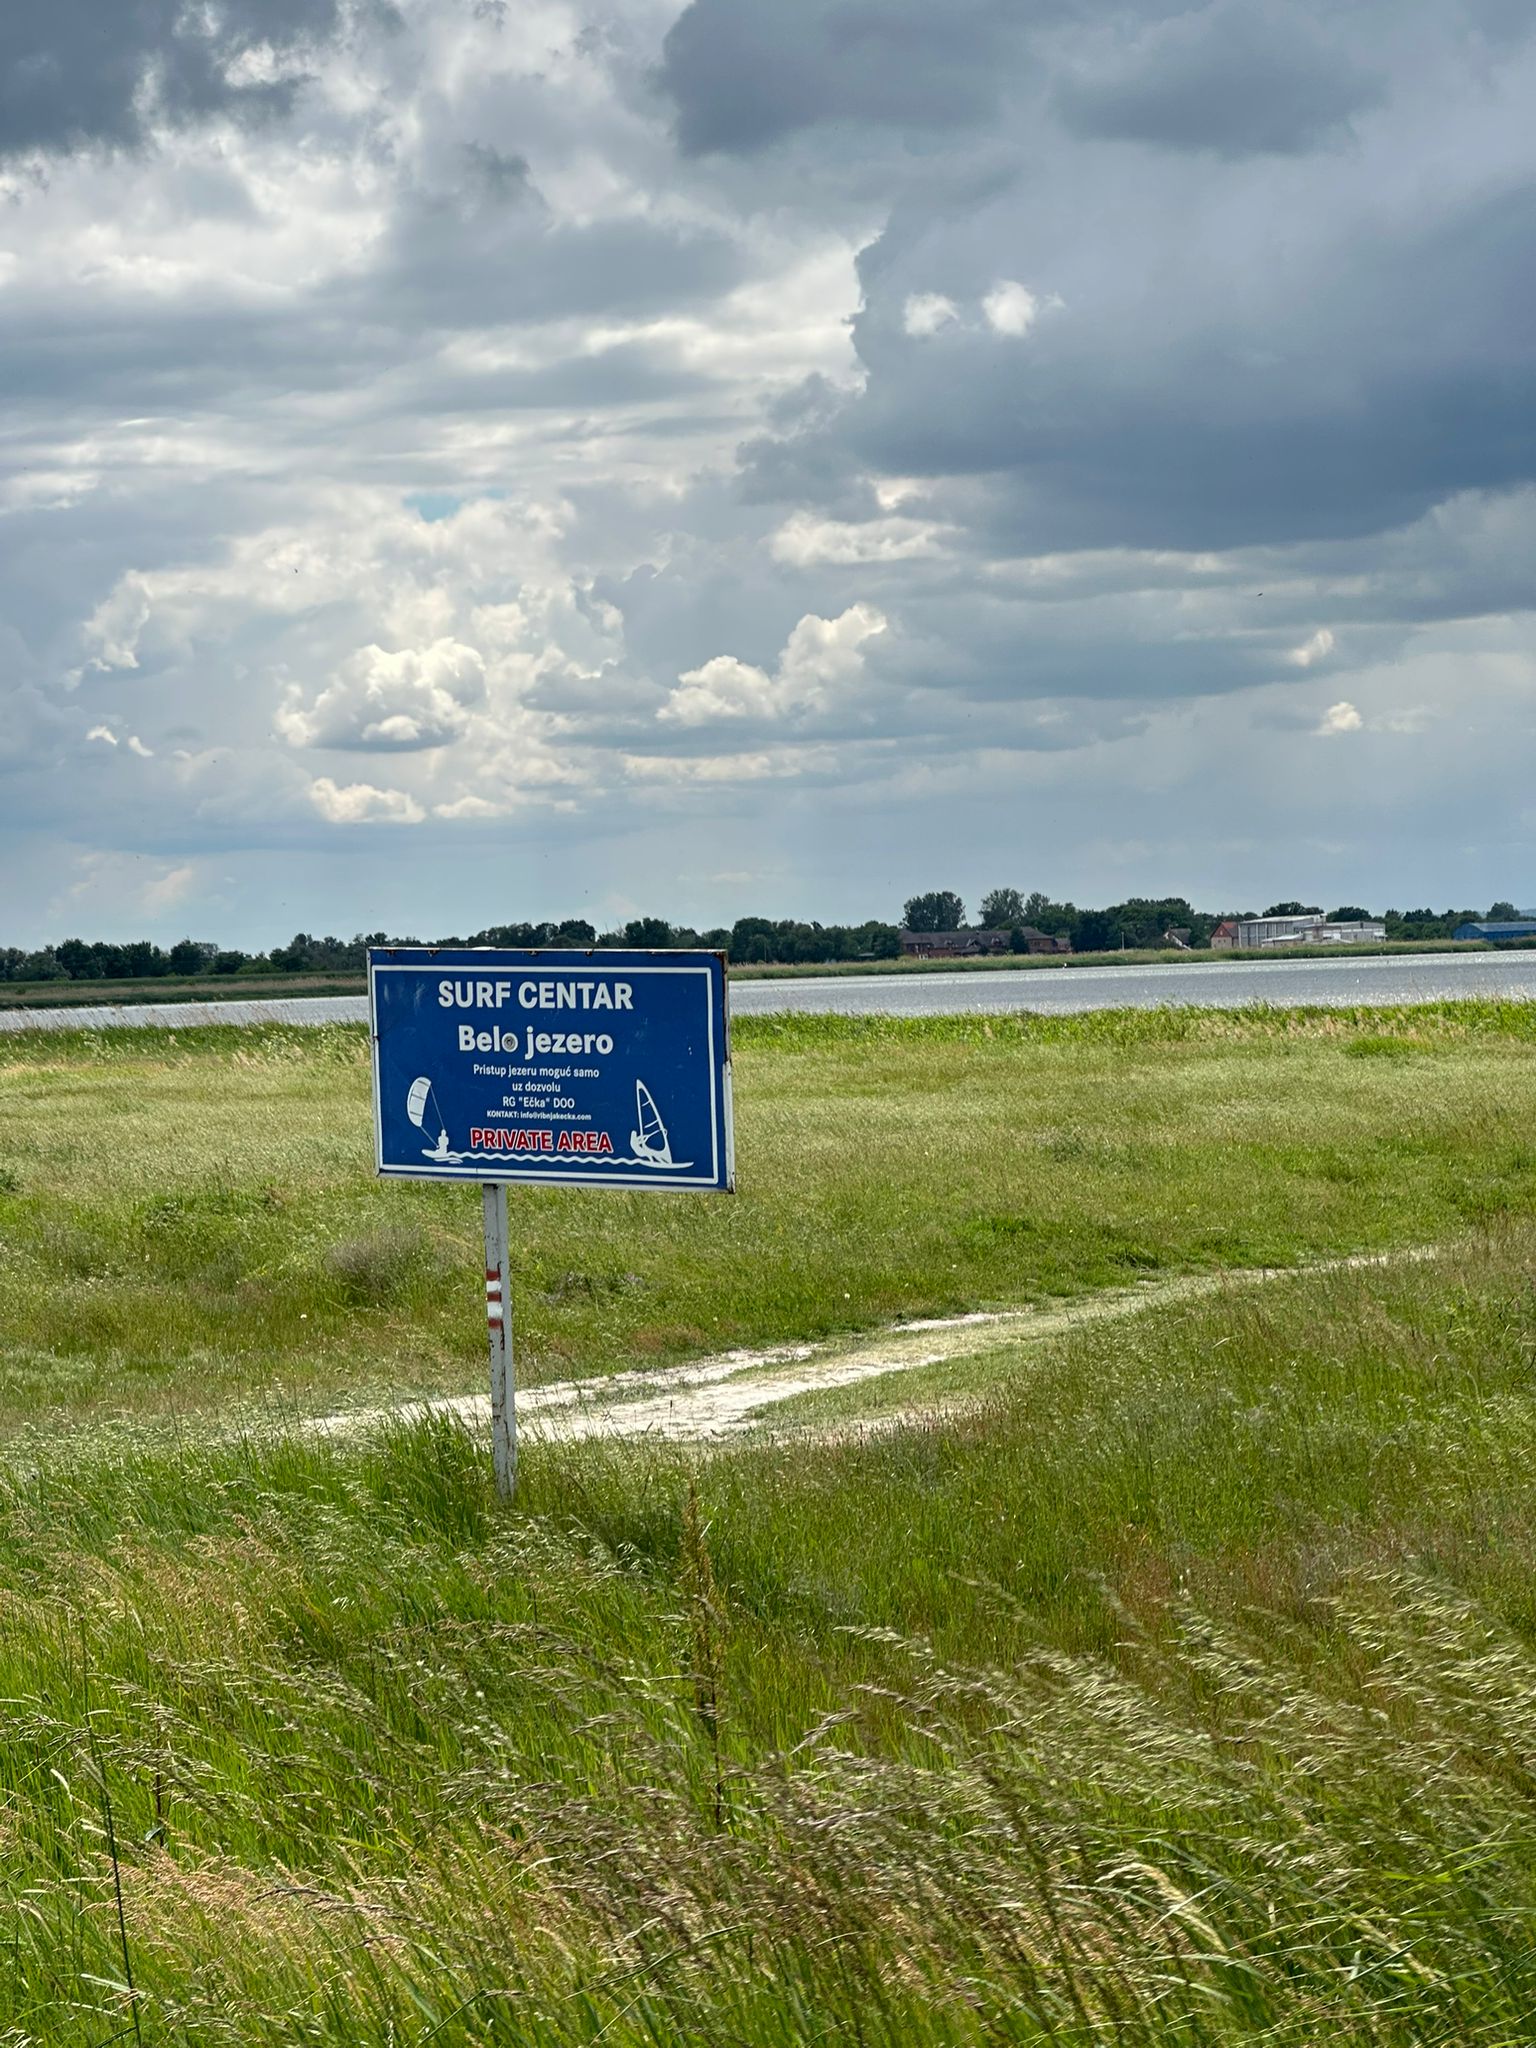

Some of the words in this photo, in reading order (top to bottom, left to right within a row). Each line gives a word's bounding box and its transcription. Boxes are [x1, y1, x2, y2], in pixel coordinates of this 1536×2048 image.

[438, 980, 511, 1008] SURF
[518, 981, 634, 1010] CENTAR
[458, 1025, 518, 1053] Belo
[524, 1026, 614, 1060] jezero
[473, 1064, 507, 1078] Pristup
[508, 1065, 537, 1078] jezeru
[539, 1065, 572, 1079] moguć
[573, 1068, 600, 1078] samo
[512, 1083, 523, 1092] uz
[525, 1081, 561, 1093] dozvolu
[503, 1096, 516, 1107] RG
[519, 1096, 550, 1108] "Ečka"
[553, 1097, 575, 1108] DOO
[487, 1110, 519, 1118] KONTAKT:
[470, 1127, 553, 1151] PRIVATE
[557, 1130, 614, 1153] AREA
